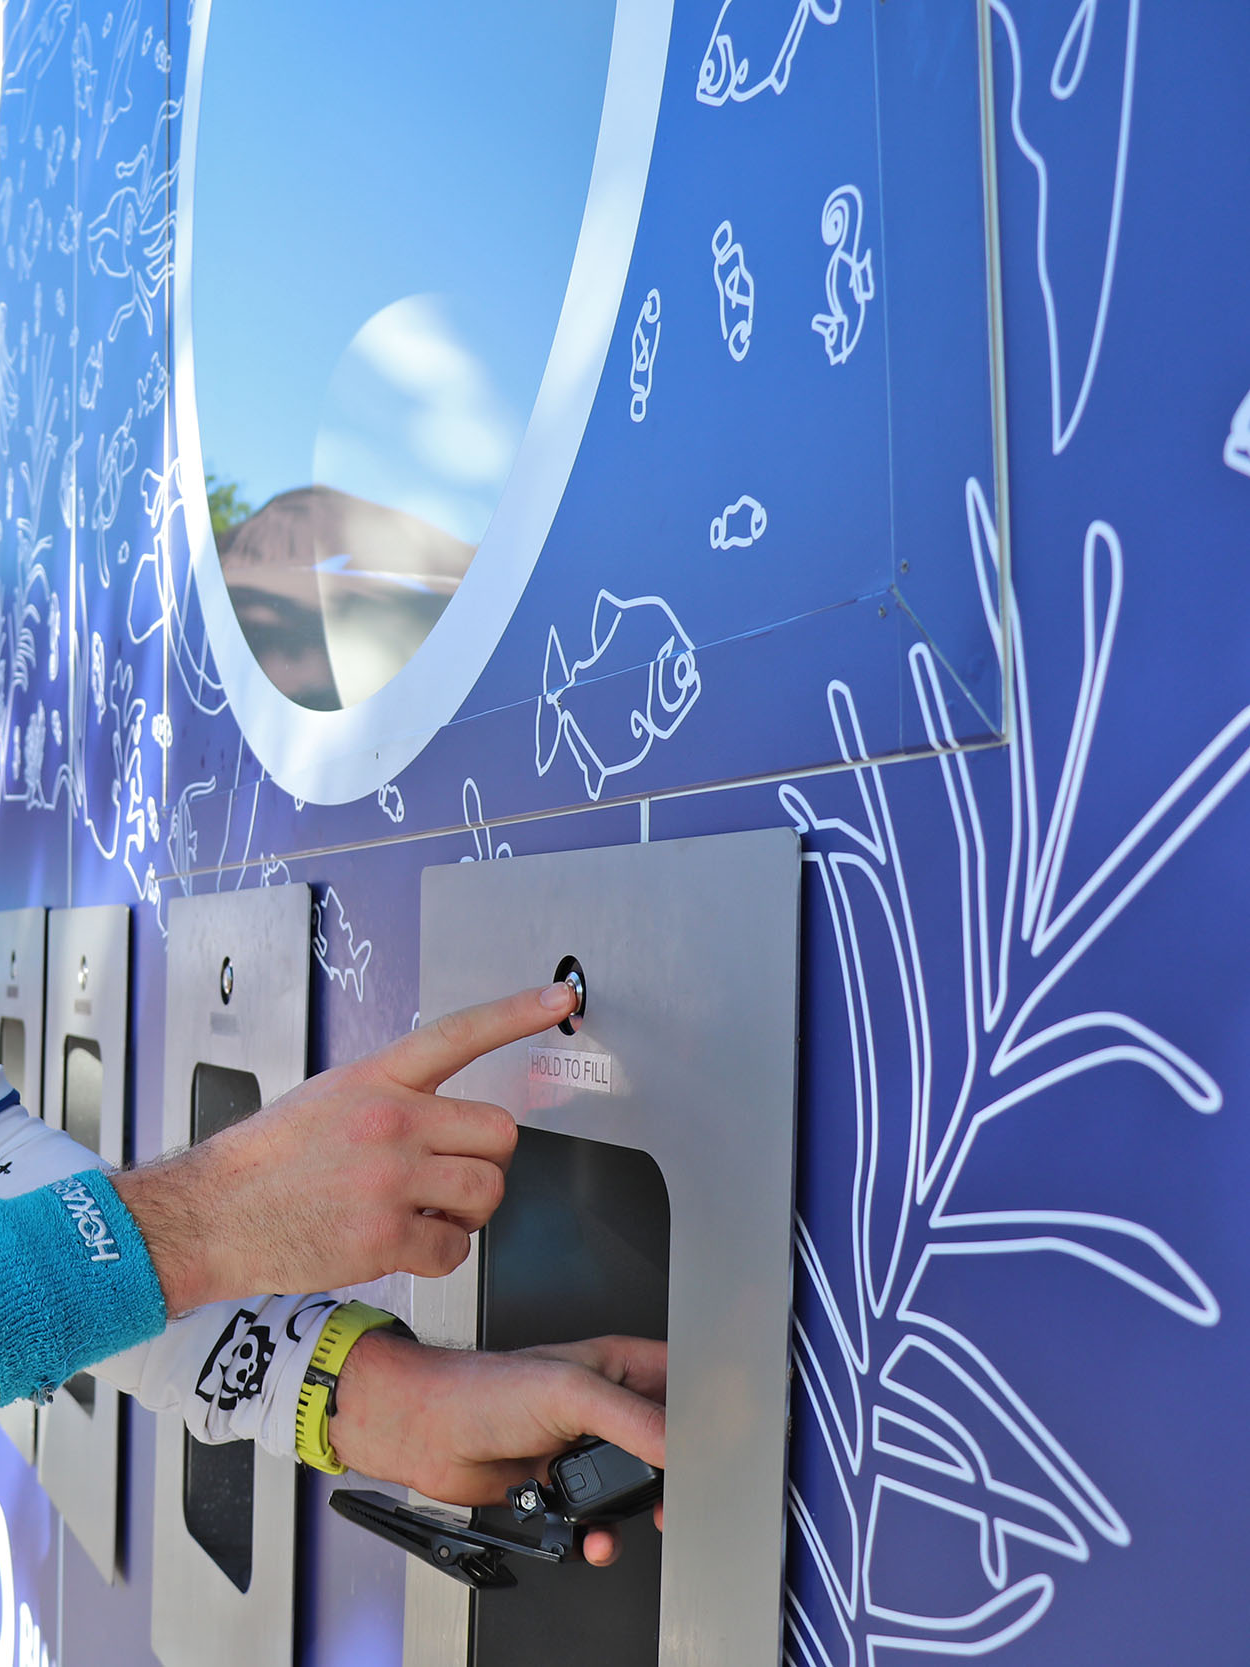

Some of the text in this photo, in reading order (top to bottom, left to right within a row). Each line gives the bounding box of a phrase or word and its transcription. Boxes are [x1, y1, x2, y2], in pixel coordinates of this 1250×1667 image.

[530, 1055, 609, 1084] HOLD TO FILL
[61, 1184, 120, 1262] HOKA
